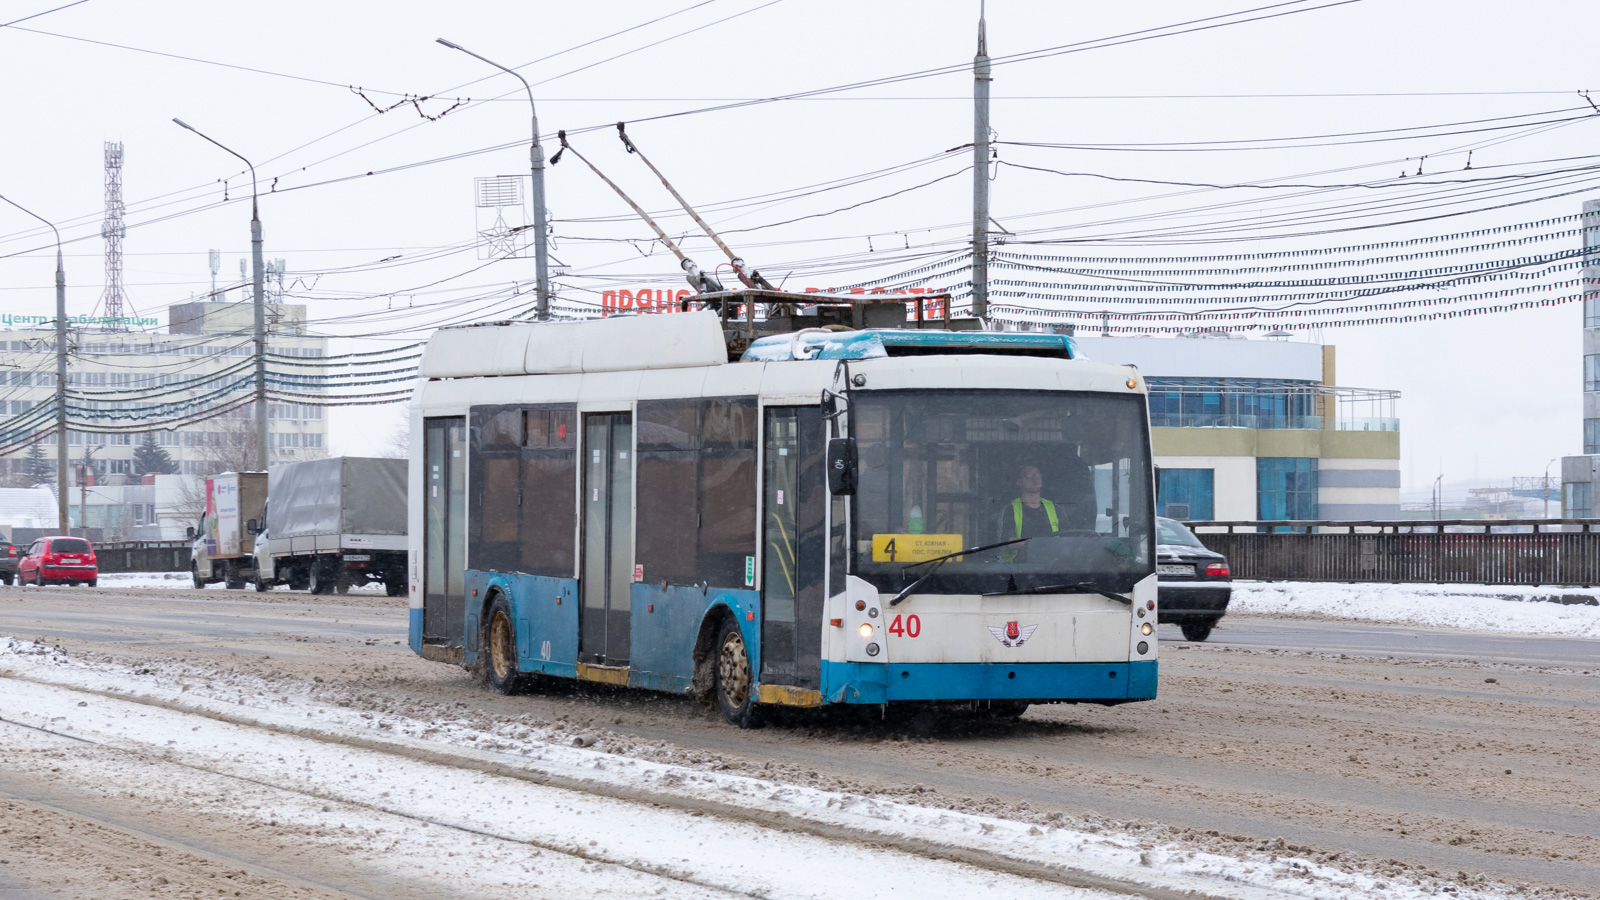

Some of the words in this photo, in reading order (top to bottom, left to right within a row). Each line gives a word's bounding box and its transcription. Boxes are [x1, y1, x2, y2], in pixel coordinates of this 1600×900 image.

[2, 313, 47, 326] Центр
[884, 537, 898, 555] 4
[888, 613, 921, 638] 40
[540, 640, 551, 661] 40
